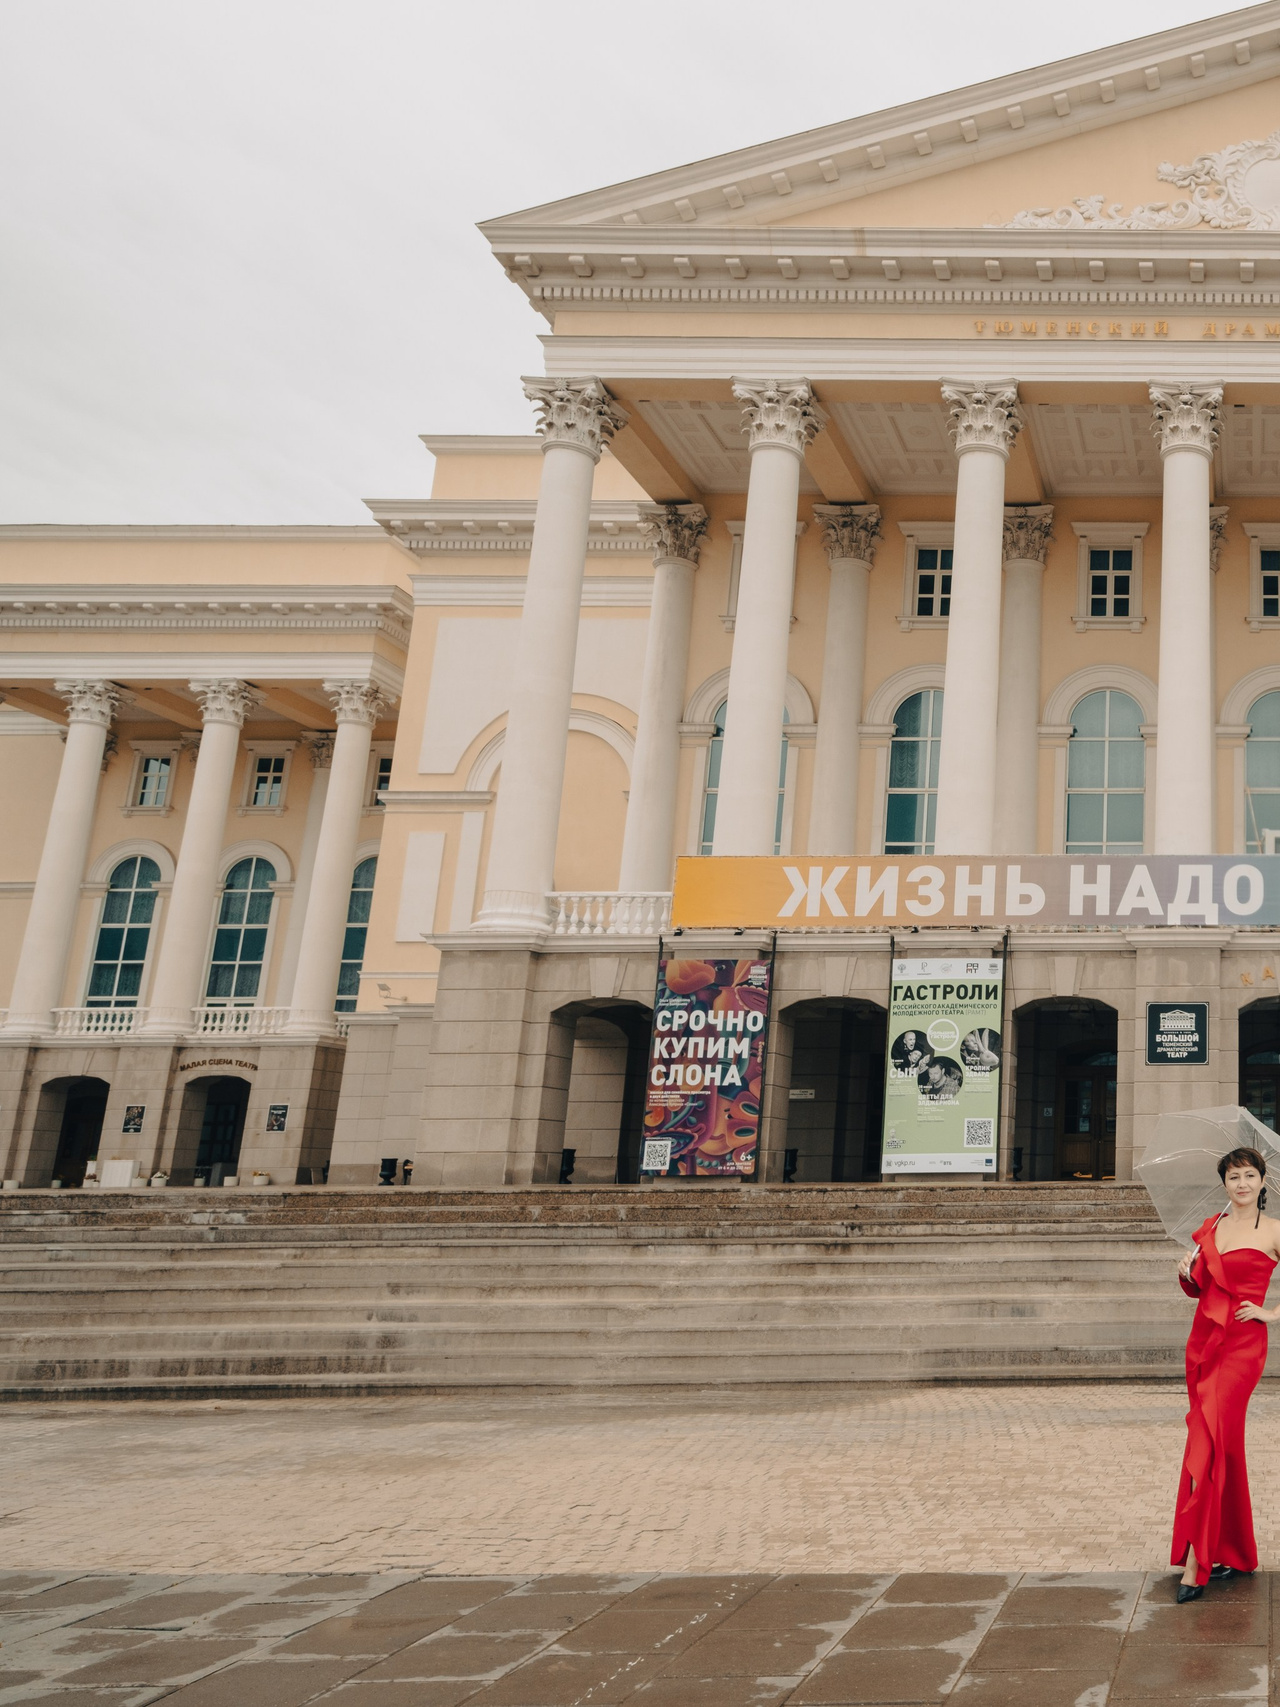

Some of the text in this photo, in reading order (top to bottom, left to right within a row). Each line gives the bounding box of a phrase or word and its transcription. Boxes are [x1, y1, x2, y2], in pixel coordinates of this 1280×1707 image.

[974, 320, 1169, 336] ТЮМЕНСКИЙ
[776, 865, 1046, 917] ЖИЗНЬ
[1069, 864, 1265, 925] НАДО
[893, 984, 998, 1001] ГАСТРОЛИ
[656, 1010, 764, 1032] СРОЧНО
[1155, 1032, 1199, 1042] БОЛЬШОЙ
[653, 1037, 750, 1059] КУПИМ
[180, 1059, 207, 1071] МАЛАЯ
[890, 1068, 918, 1078] СЫН
[651, 1064, 742, 1086] СЛОНА
[740, 1152, 753, 1161] 6+
